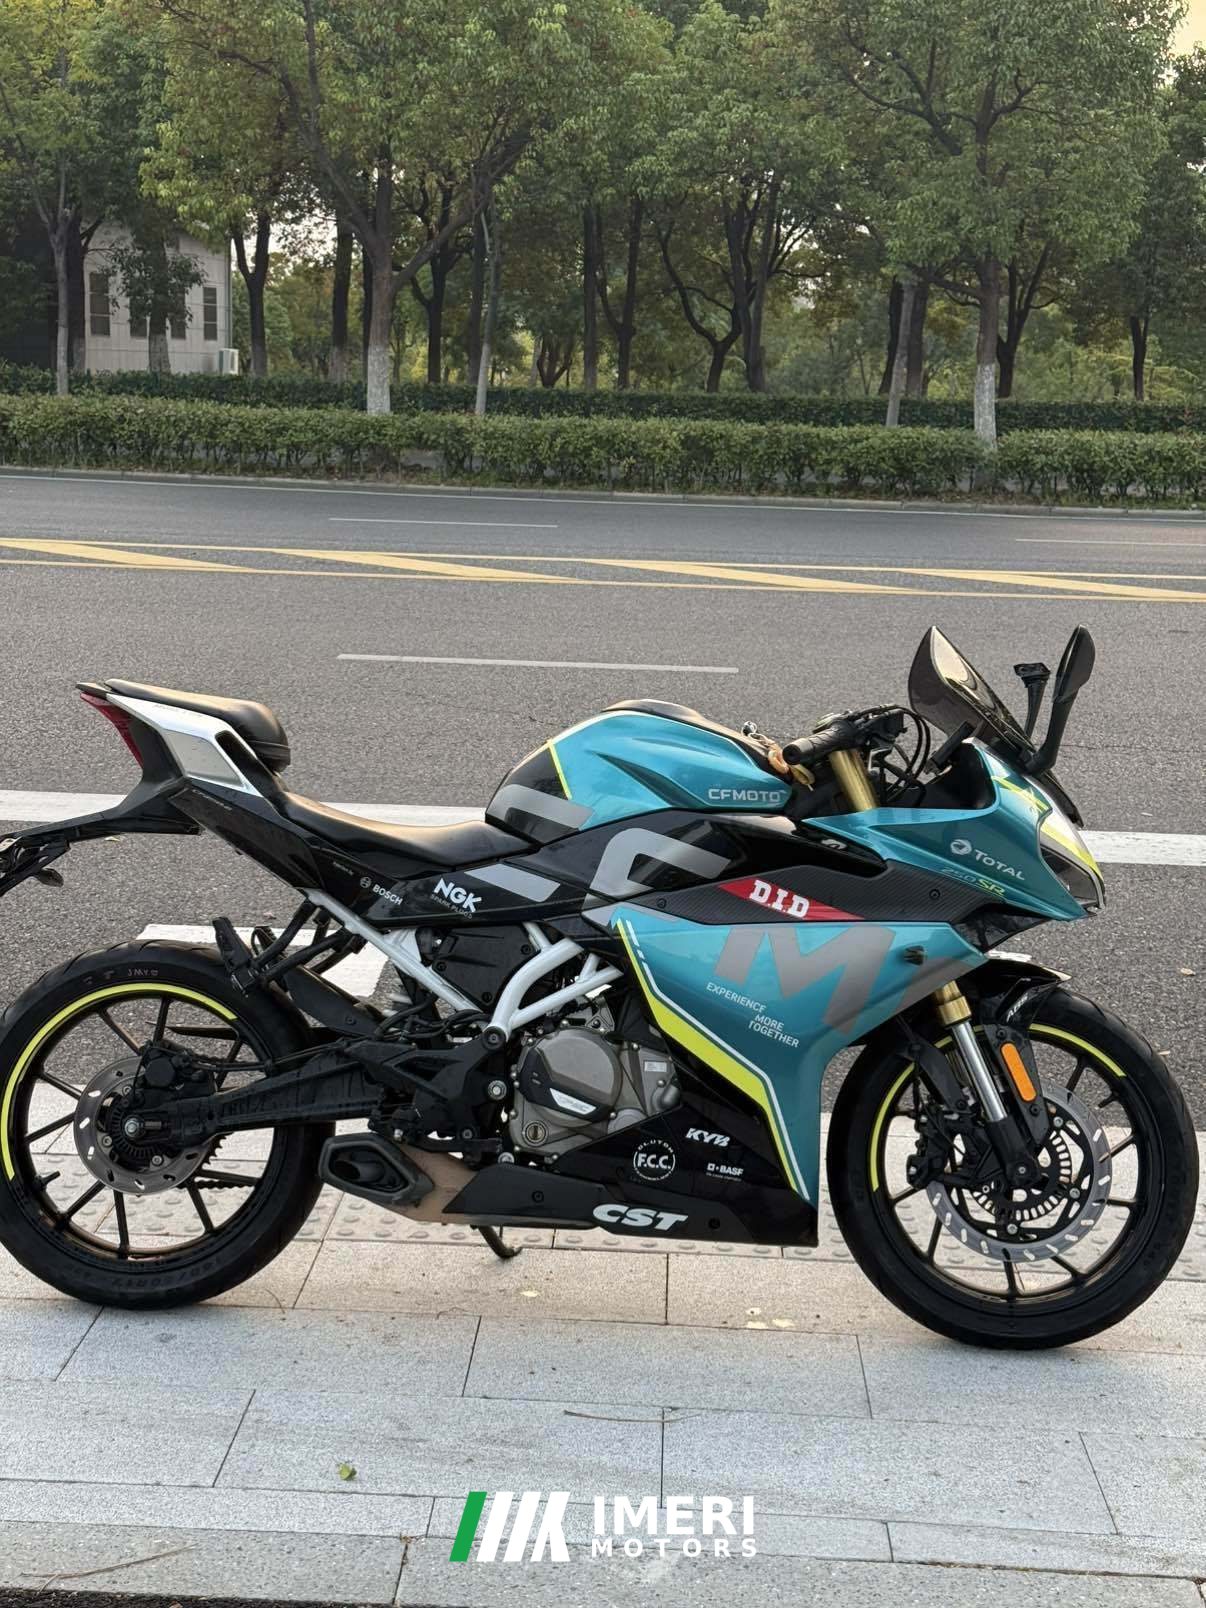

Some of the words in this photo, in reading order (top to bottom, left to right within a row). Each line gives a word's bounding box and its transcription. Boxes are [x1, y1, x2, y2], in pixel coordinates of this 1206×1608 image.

[708, 788, 781, 802] CFMOTO
[974, 849, 1025, 880] TOTAL
[372, 883, 403, 905] BOSCH
[433, 877, 482, 913] NGK
[706, 982, 767, 1013] EXPERIENCE
[754, 1013, 785, 1032] MORE
[748, 1020, 800, 1048] TOGETHER
[685, 1127, 731, 1147] KYB
[637, 1153, 671, 1169] F.C.C.
[719, 1164, 744, 1177] BASF
[592, 1203, 689, 1232] CST
